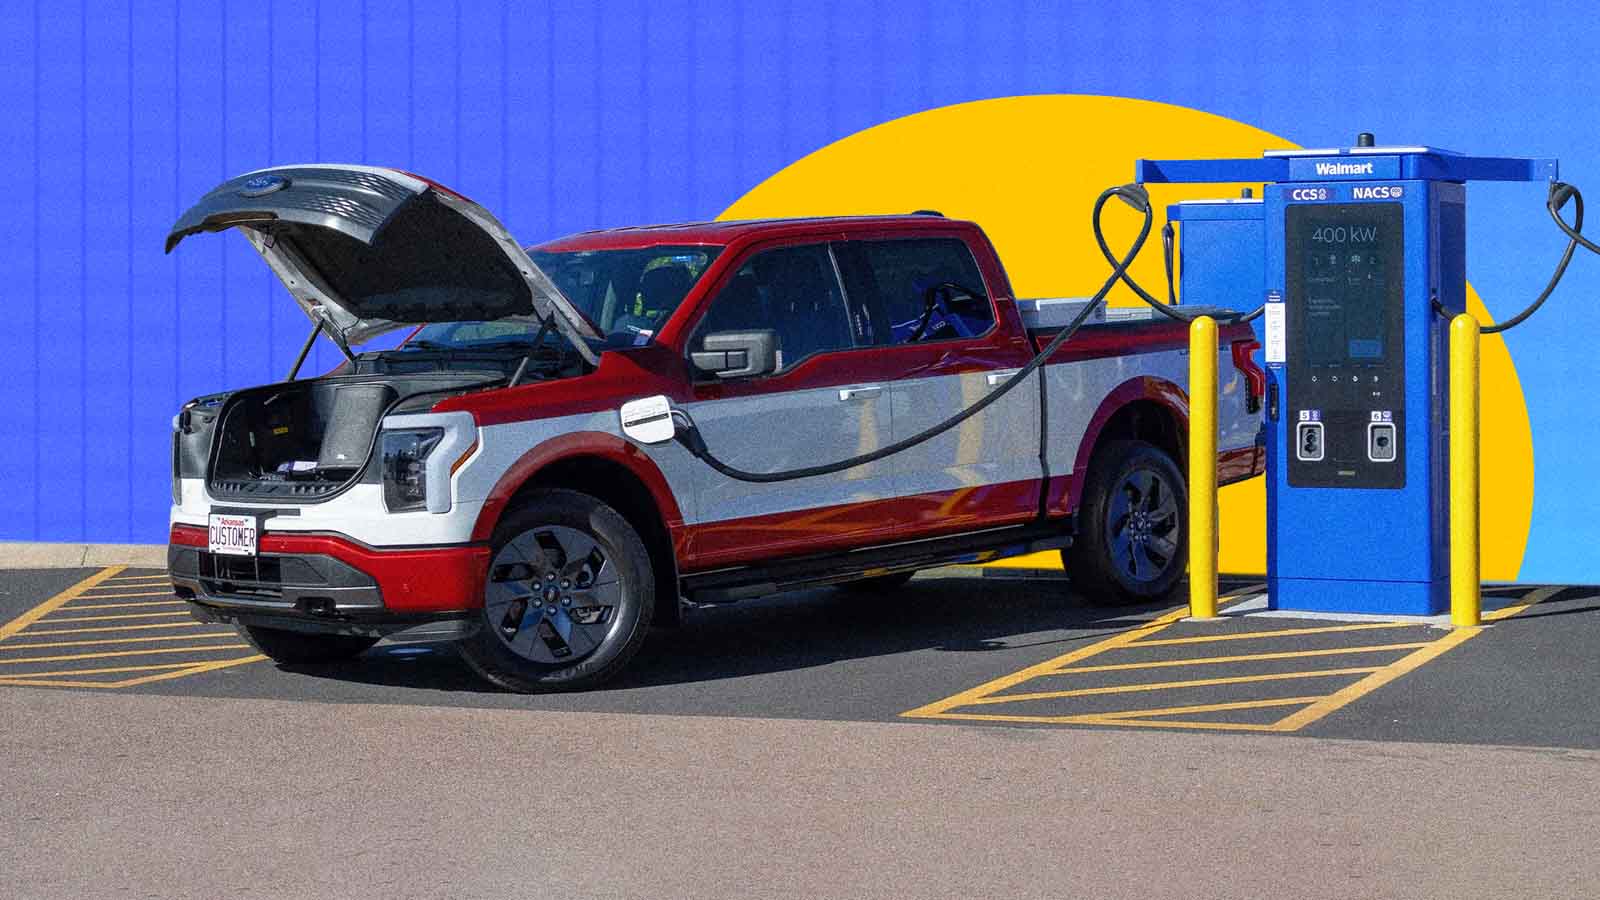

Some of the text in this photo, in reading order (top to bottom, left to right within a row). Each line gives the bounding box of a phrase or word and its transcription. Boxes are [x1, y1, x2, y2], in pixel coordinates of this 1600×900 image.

[1316, 163, 1373, 175] Walmart
[1293, 189, 1318, 200] CCS
[1353, 187, 1389, 199] NACS
[1312, 226, 1377, 242] 400 kW
[221, 517, 245, 526] Arkansas
[210, 526, 255, 547] CUSTOMER
